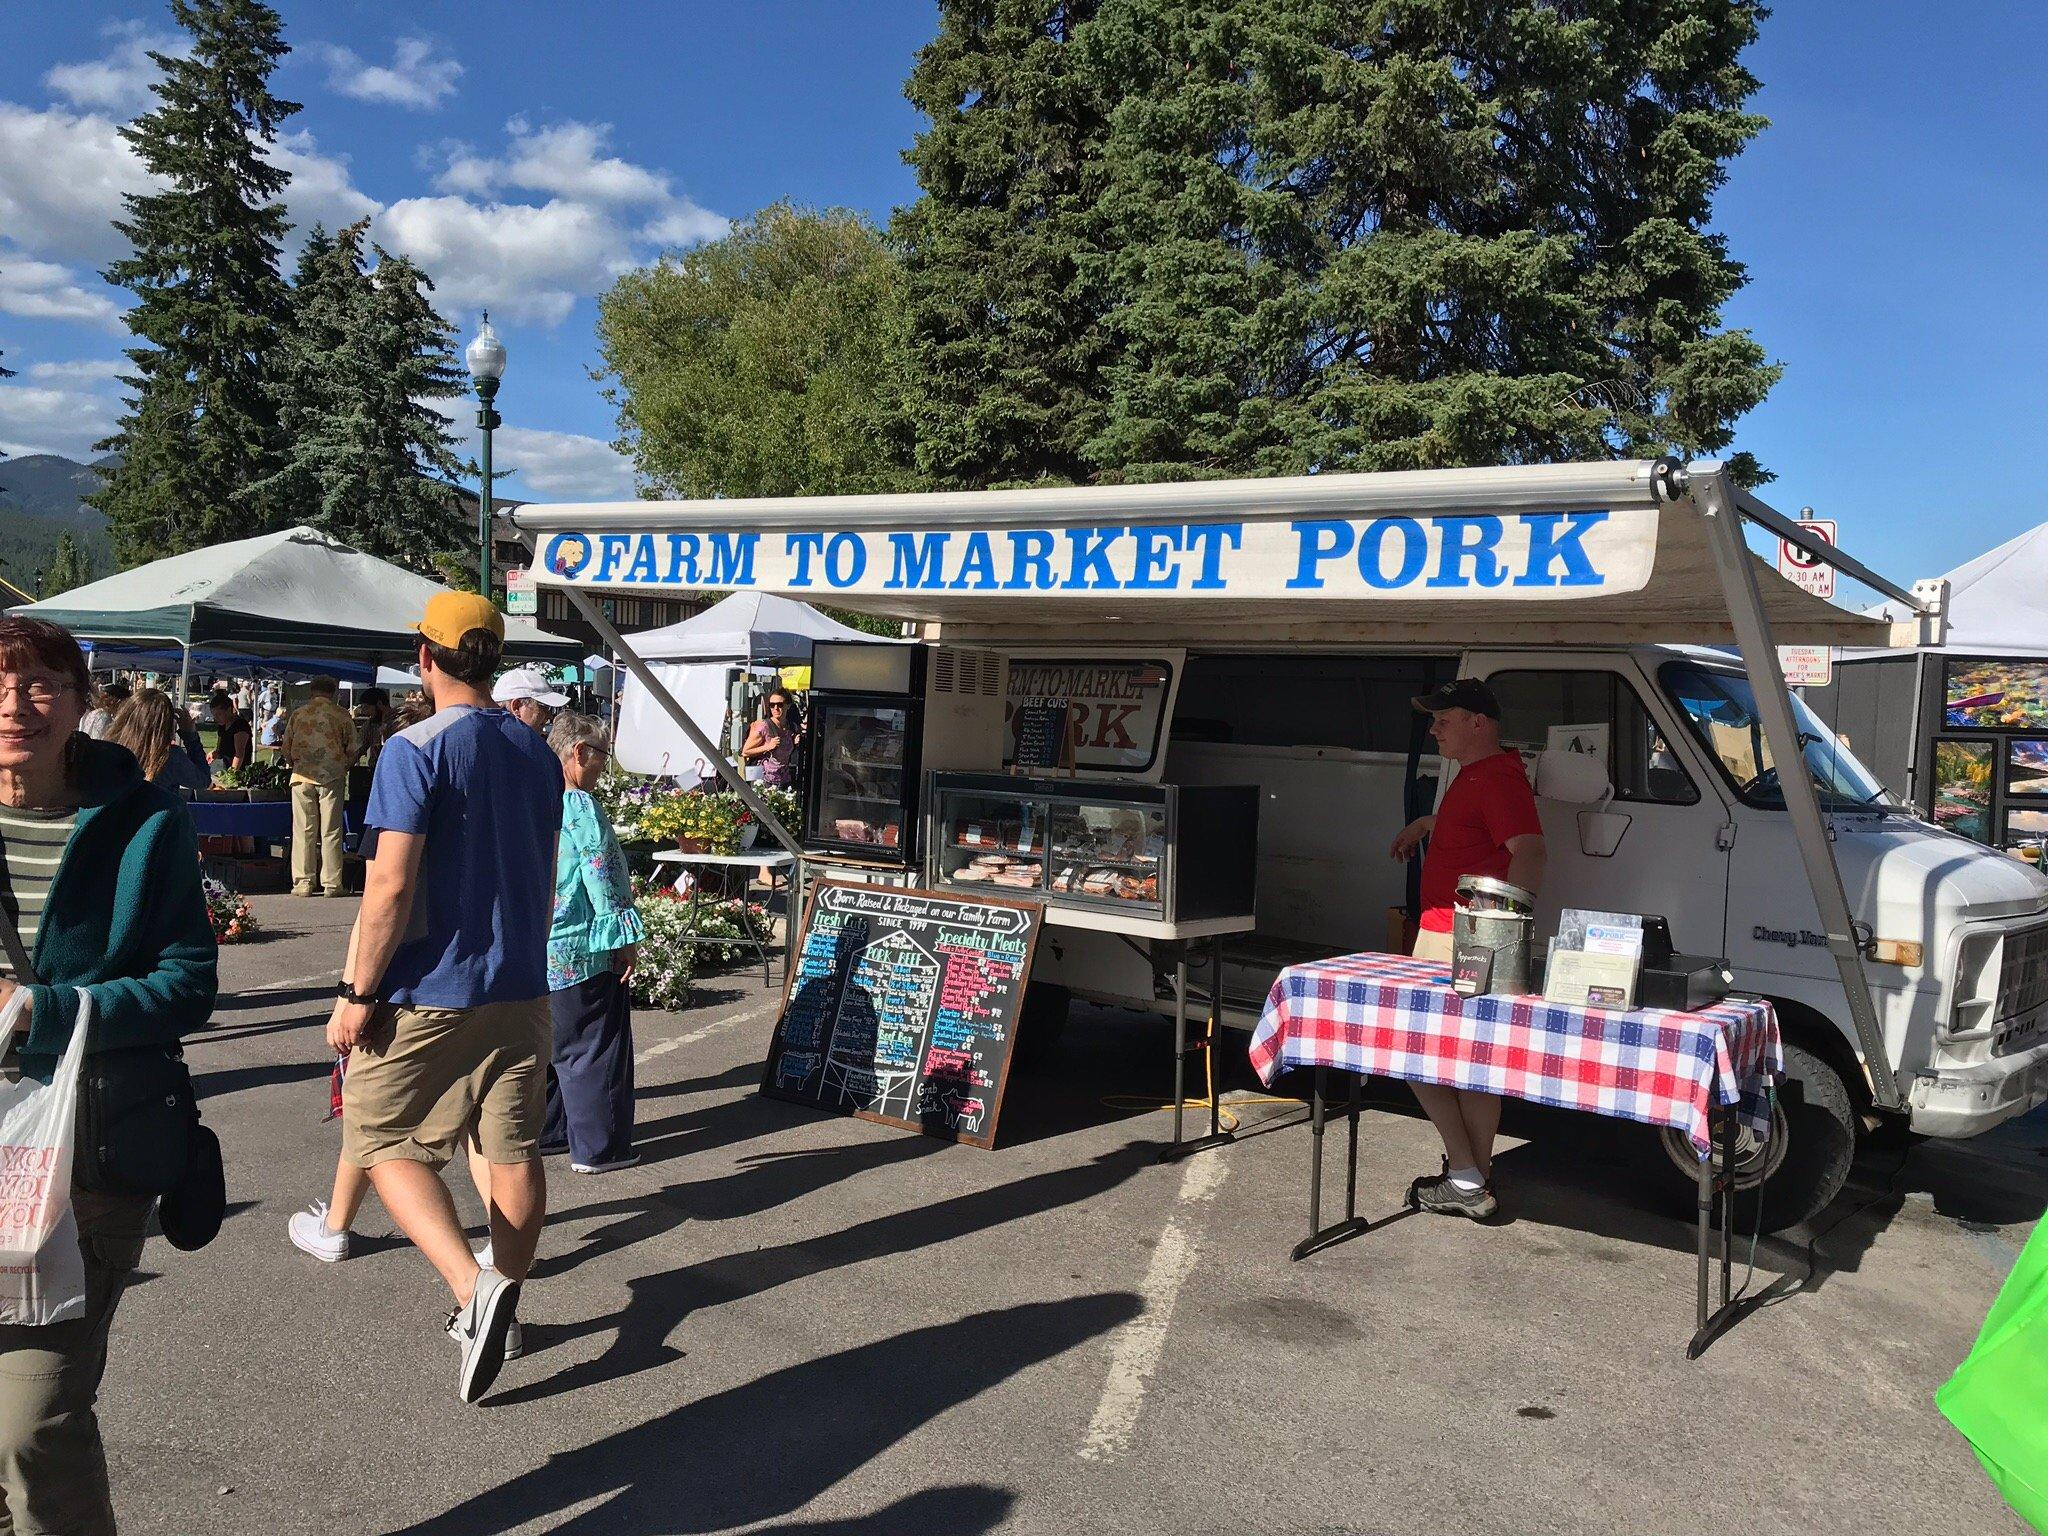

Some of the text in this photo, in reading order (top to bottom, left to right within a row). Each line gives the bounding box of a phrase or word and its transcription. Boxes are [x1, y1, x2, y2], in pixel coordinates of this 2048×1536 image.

[593, 509, 1610, 590] FARM TO MARKET PORK
[1813, 572, 1824, 581] AM
[1818, 585, 1829, 594] AM
[1023, 697, 1068, 708] BEEF CUTS
[1568, 736, 1596, 754] A+
[856, 894, 882, 908] Raised
[883, 897, 892, 910] &
[894, 898, 929, 917] Packaged
[931, 908, 940, 916] on
[942, 909, 956, 918] our
[958, 906, 986, 926] Family
[986, 909, 1010, 926] Farm
[814, 910, 868, 929] Fresh Cuts
[877, 917, 903, 928] SINCE
[936, 926, 1028, 954] Specialty Meats
[1753, 926, 1797, 947] Chevy
[866, 946, 892, 963] PORK
[898, 952, 924, 966] BEEF
[987, 950, 1000, 960] Blue
[1005, 954, 1020, 962] Raw
[938, 1007, 960, 1018] Chorizo
[879, 1029, 896, 1041] Beef
[898, 1031, 913, 1043] Box
[917, 1082, 937, 1096] Grab
